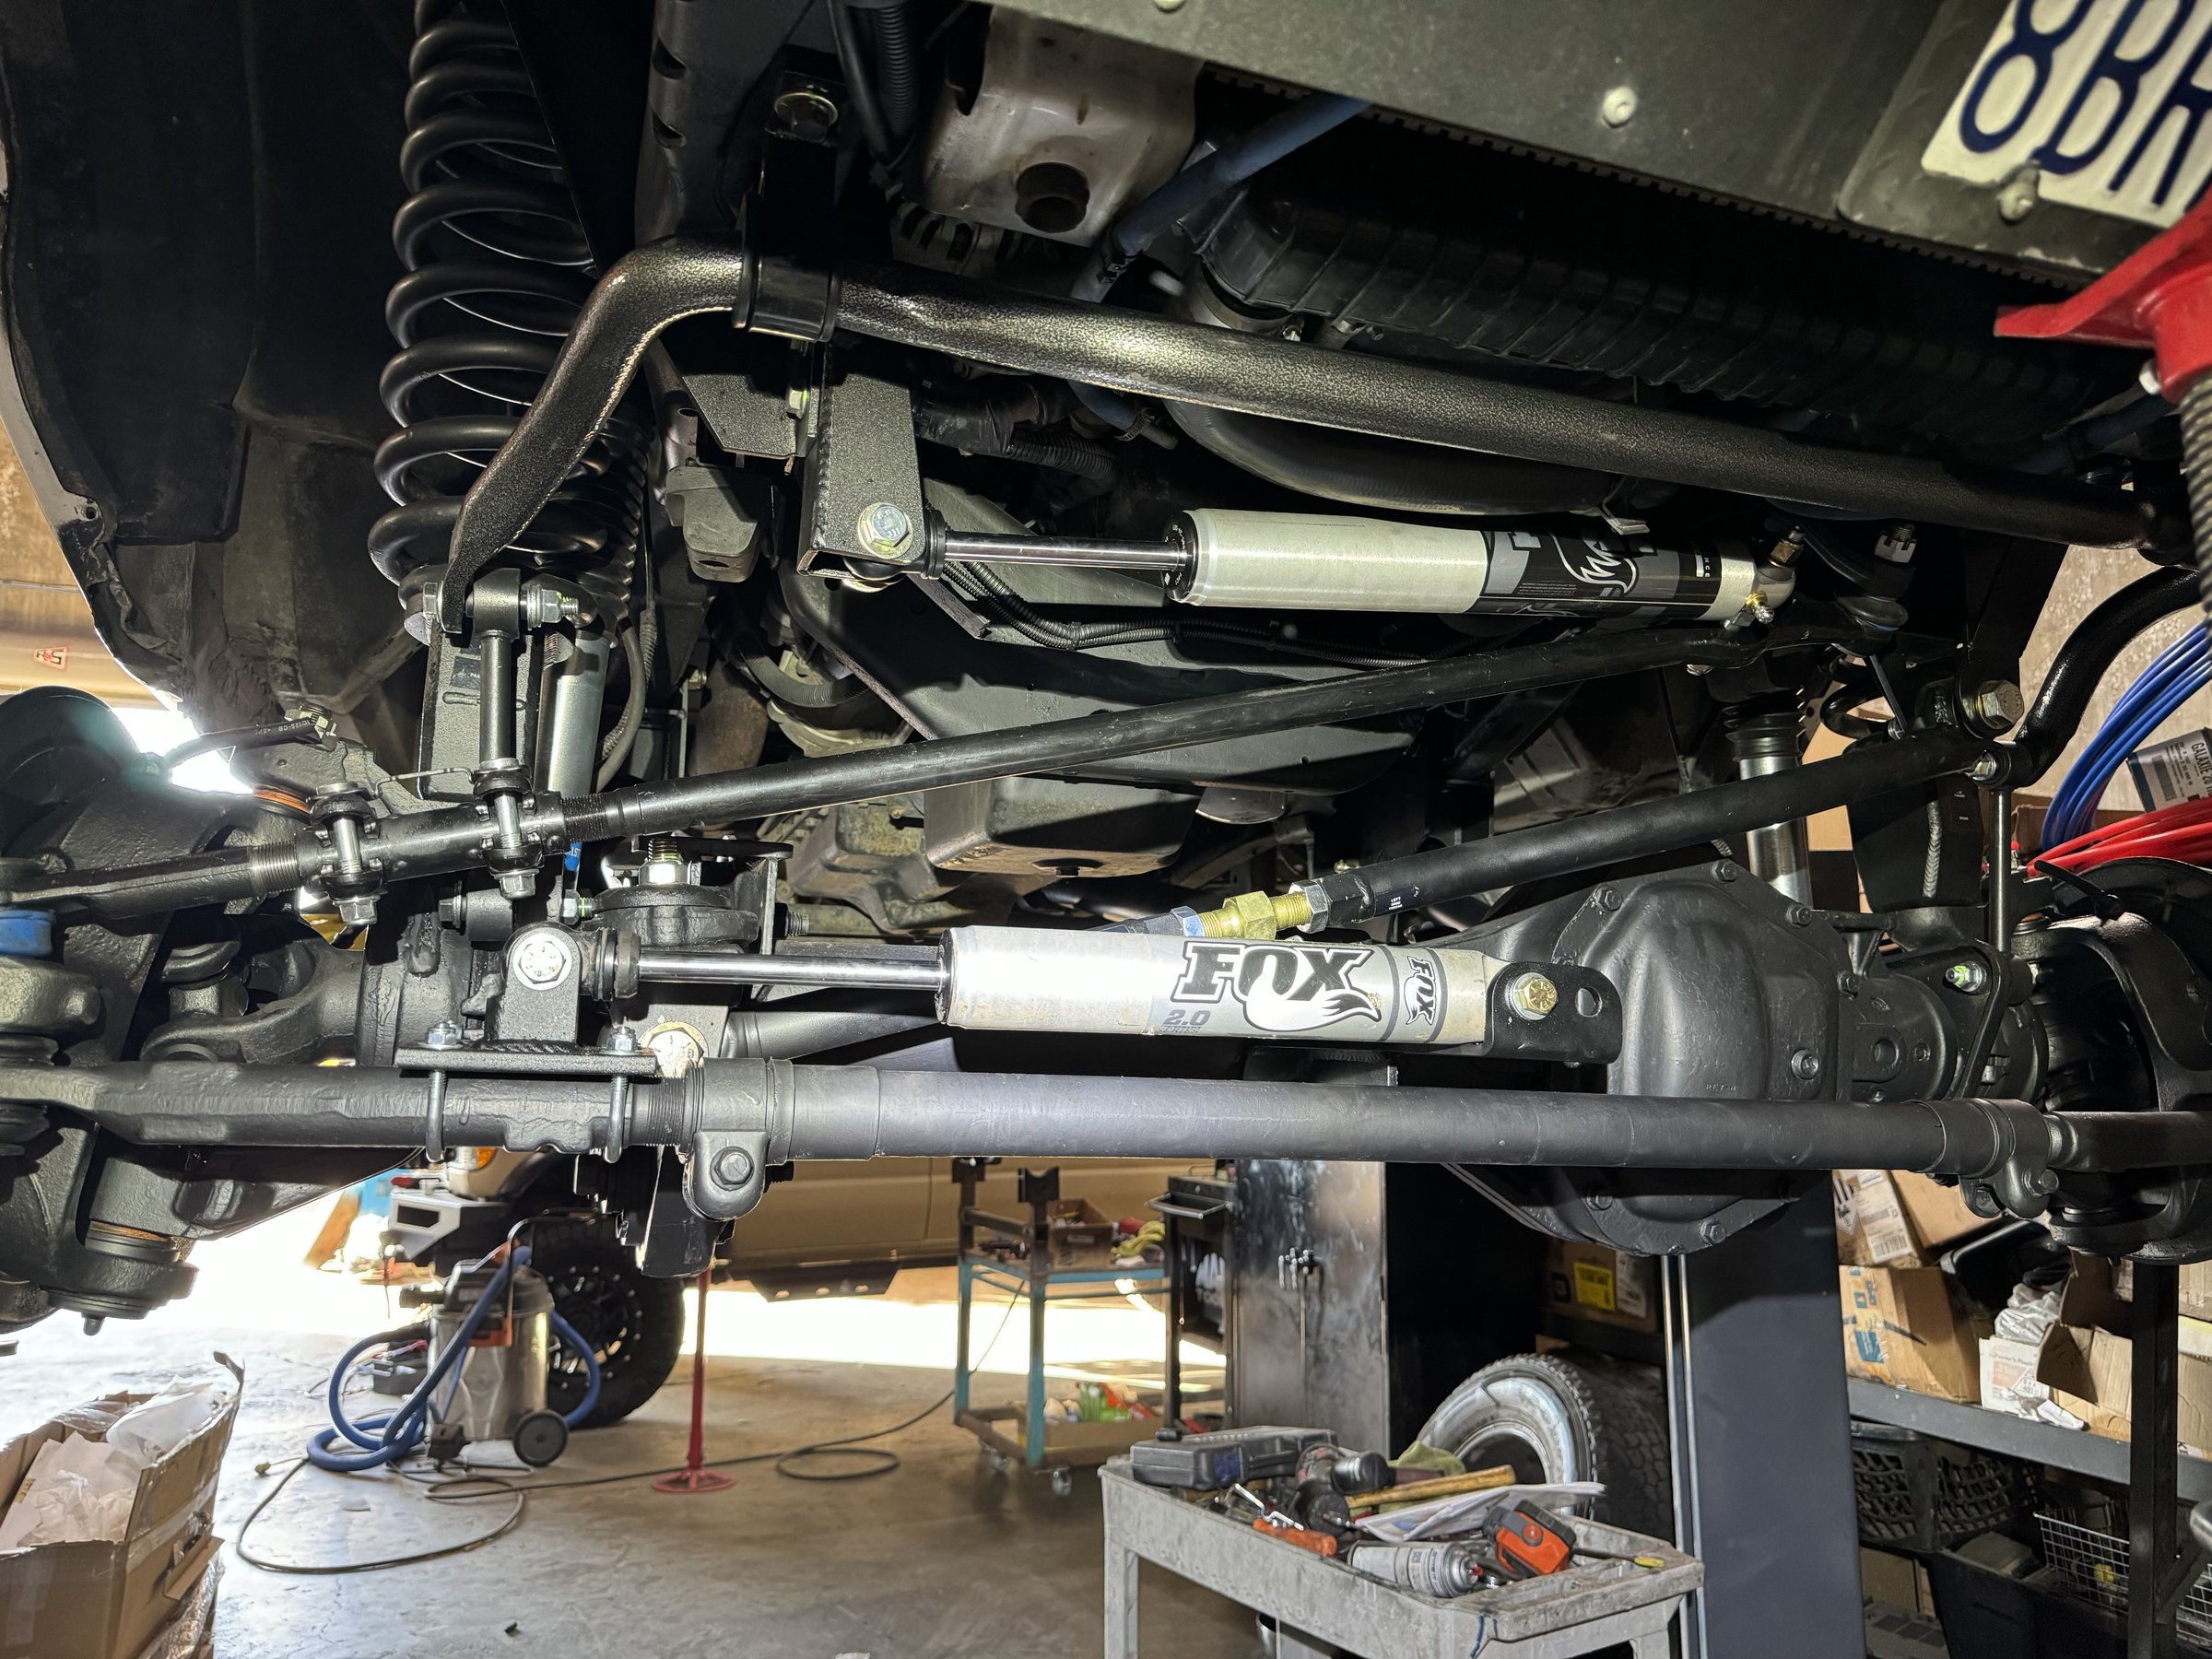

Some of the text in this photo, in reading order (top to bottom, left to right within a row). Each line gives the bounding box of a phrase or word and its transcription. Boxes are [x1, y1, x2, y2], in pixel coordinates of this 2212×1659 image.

[1959, 0, 2212, 214] 8BR
[1171, 941, 1377, 1010] FOX
[1408, 956, 1436, 1024] FOX
[1162, 1009, 1210, 1026] 2.0
